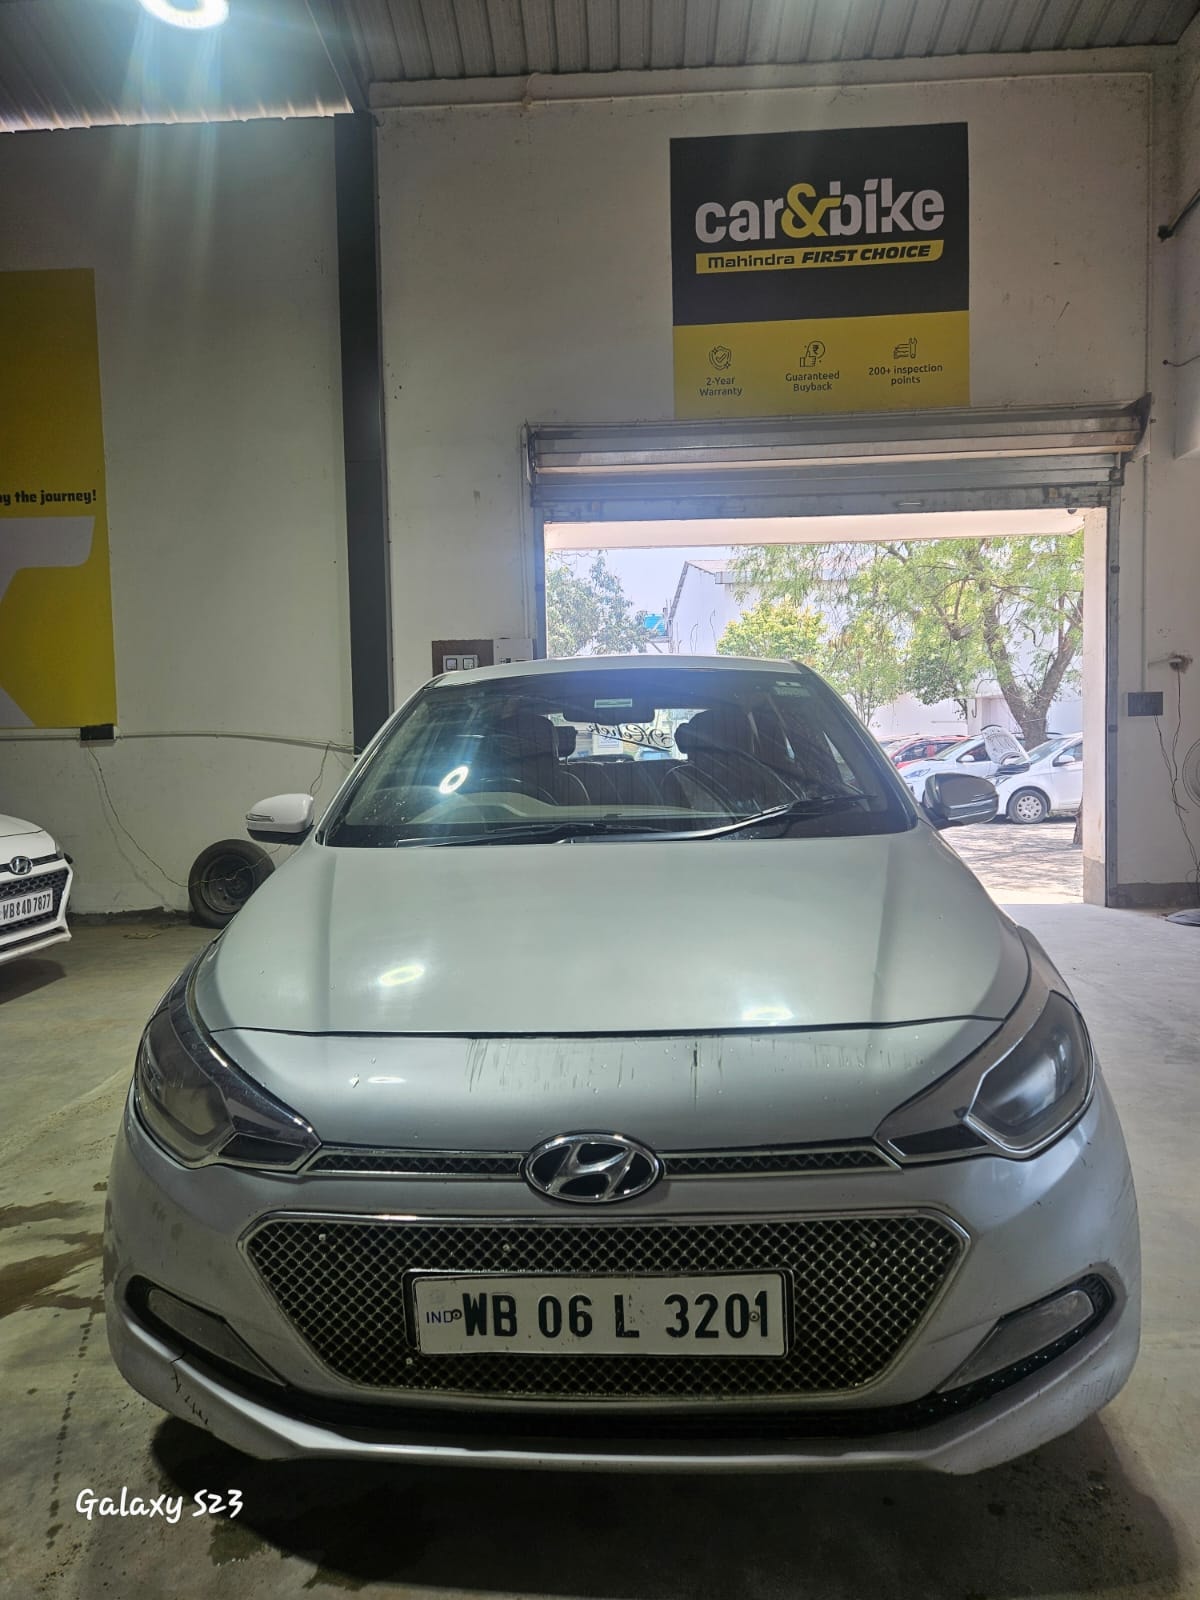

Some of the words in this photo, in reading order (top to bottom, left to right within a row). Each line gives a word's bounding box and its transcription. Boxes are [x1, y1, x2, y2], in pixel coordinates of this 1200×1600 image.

[695, 178, 945, 244] car&bike
[708, 253, 795, 269] Mahindra
[801, 249, 857, 264] FIRST
[860, 245, 931, 261] CHOICE
[868, 366, 891, 376] 200+
[893, 363, 943, 376] inspection
[706, 376, 736, 386] 2-Year
[785, 371, 840, 382] Guaranteed
[890, 375, 921, 386] points
[699, 386, 743, 398] Warranty
[793, 381, 832, 393] Buyback
[15, 490, 37, 503] the
[40, 489, 97, 506] journey!
[462, 1292, 518, 1337] WB
[538, 1293, 593, 1339] 06
[614, 1294, 640, 1339] L
[664, 1290, 769, 1339] 3201
